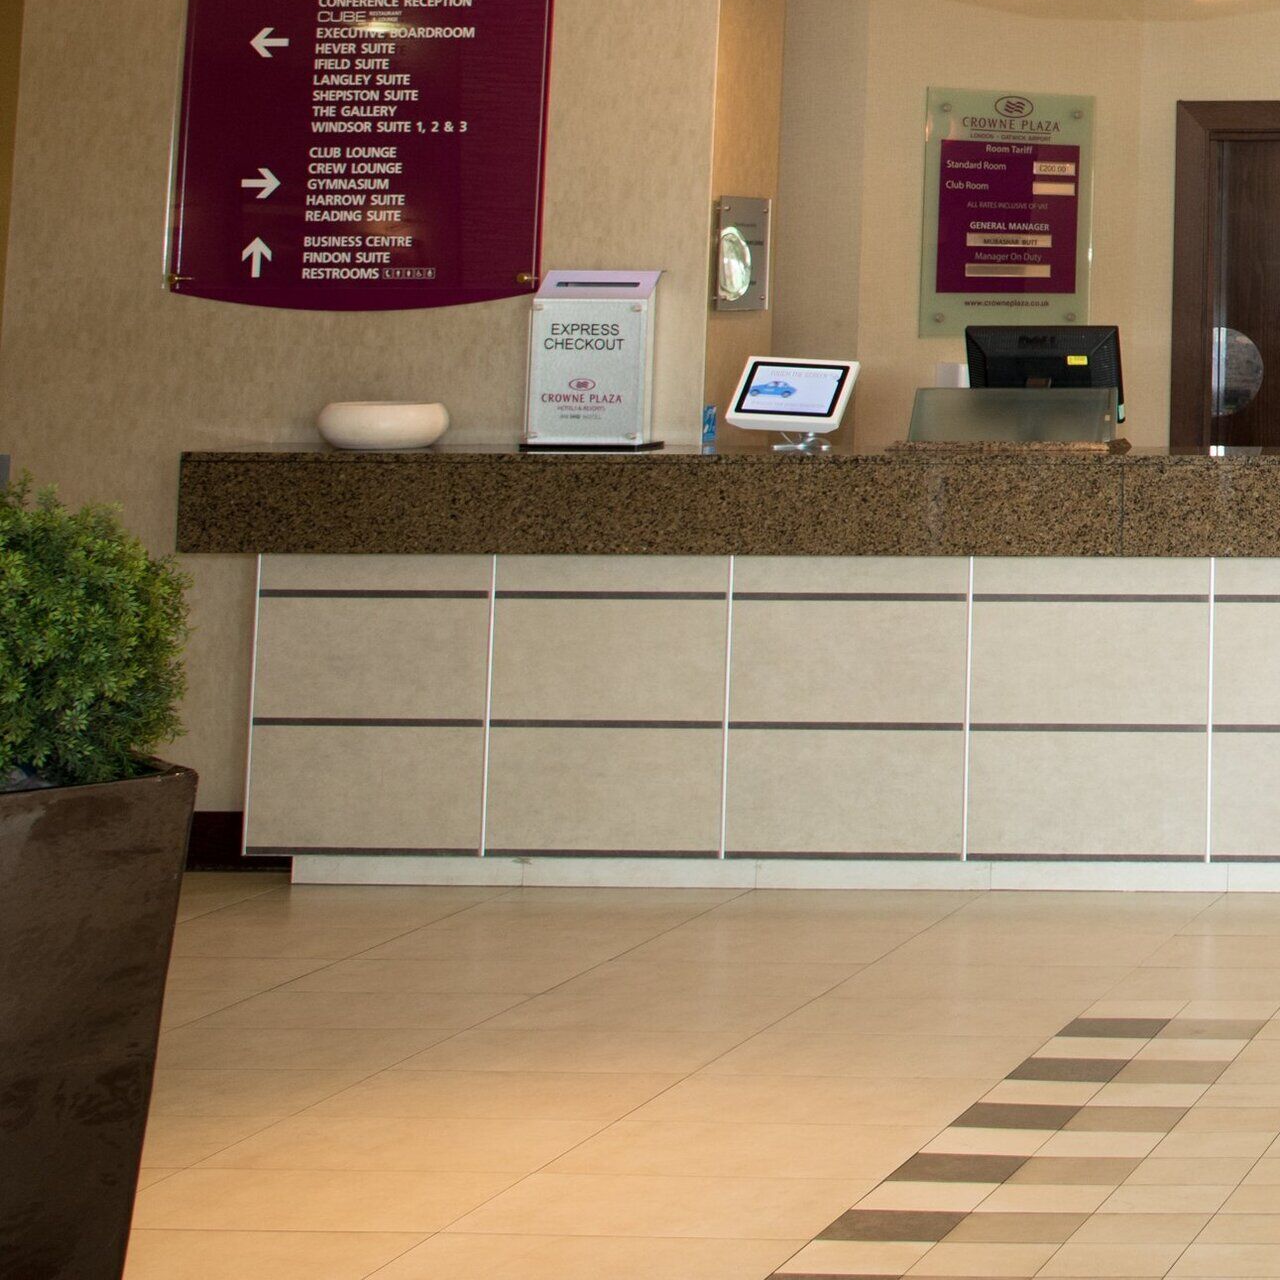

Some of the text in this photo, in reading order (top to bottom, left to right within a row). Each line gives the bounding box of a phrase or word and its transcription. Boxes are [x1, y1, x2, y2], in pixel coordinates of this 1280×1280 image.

[317, 11, 366, 22] CUBE
[316, 27, 476, 39] EXECUTIVE BOARDROOM
[315, 43, 395, 54] HEVER SUITE
[314, 59, 389, 70] IFIELD SUITE
[313, 74, 411, 86] LANGLEY SUITE
[312, 90, 418, 101] SHEPISTON SUITE
[312, 105, 398, 117] THE GALLERY
[311, 121, 468, 134] WINDSOR SUITE 1, 2 & 3
[962, 116, 1060, 132] CROWNE PLAZA
[309, 147, 397, 159] CLUB LOUNGE
[985, 144, 1033, 154] Room Tariff
[308, 163, 402, 174] CREW LOUNGE
[946, 160, 1007, 171] Standard Room
[307, 178, 389, 190] GYMNASIUM
[945, 180, 989, 190] Club Room
[306, 194, 405, 206] HARROW SUITE
[305, 210, 401, 222] READING SUITE
[969, 221, 1050, 231] GENERAL MANAGER
[303, 236, 412, 247] BUSINESS CENTRE
[303, 252, 390, 263] FINDON SUITE
[975, 252, 1042, 264] Manager On Duty
[301, 268, 380, 280] RESTROOMS
[964, 300, 1049, 308] www.crowneplaza.co.uk
[551, 323, 620, 336] EXPRESS
[543, 337, 625, 350] CHECKOUT
[541, 393, 622, 404] CROWNE PLAZA
